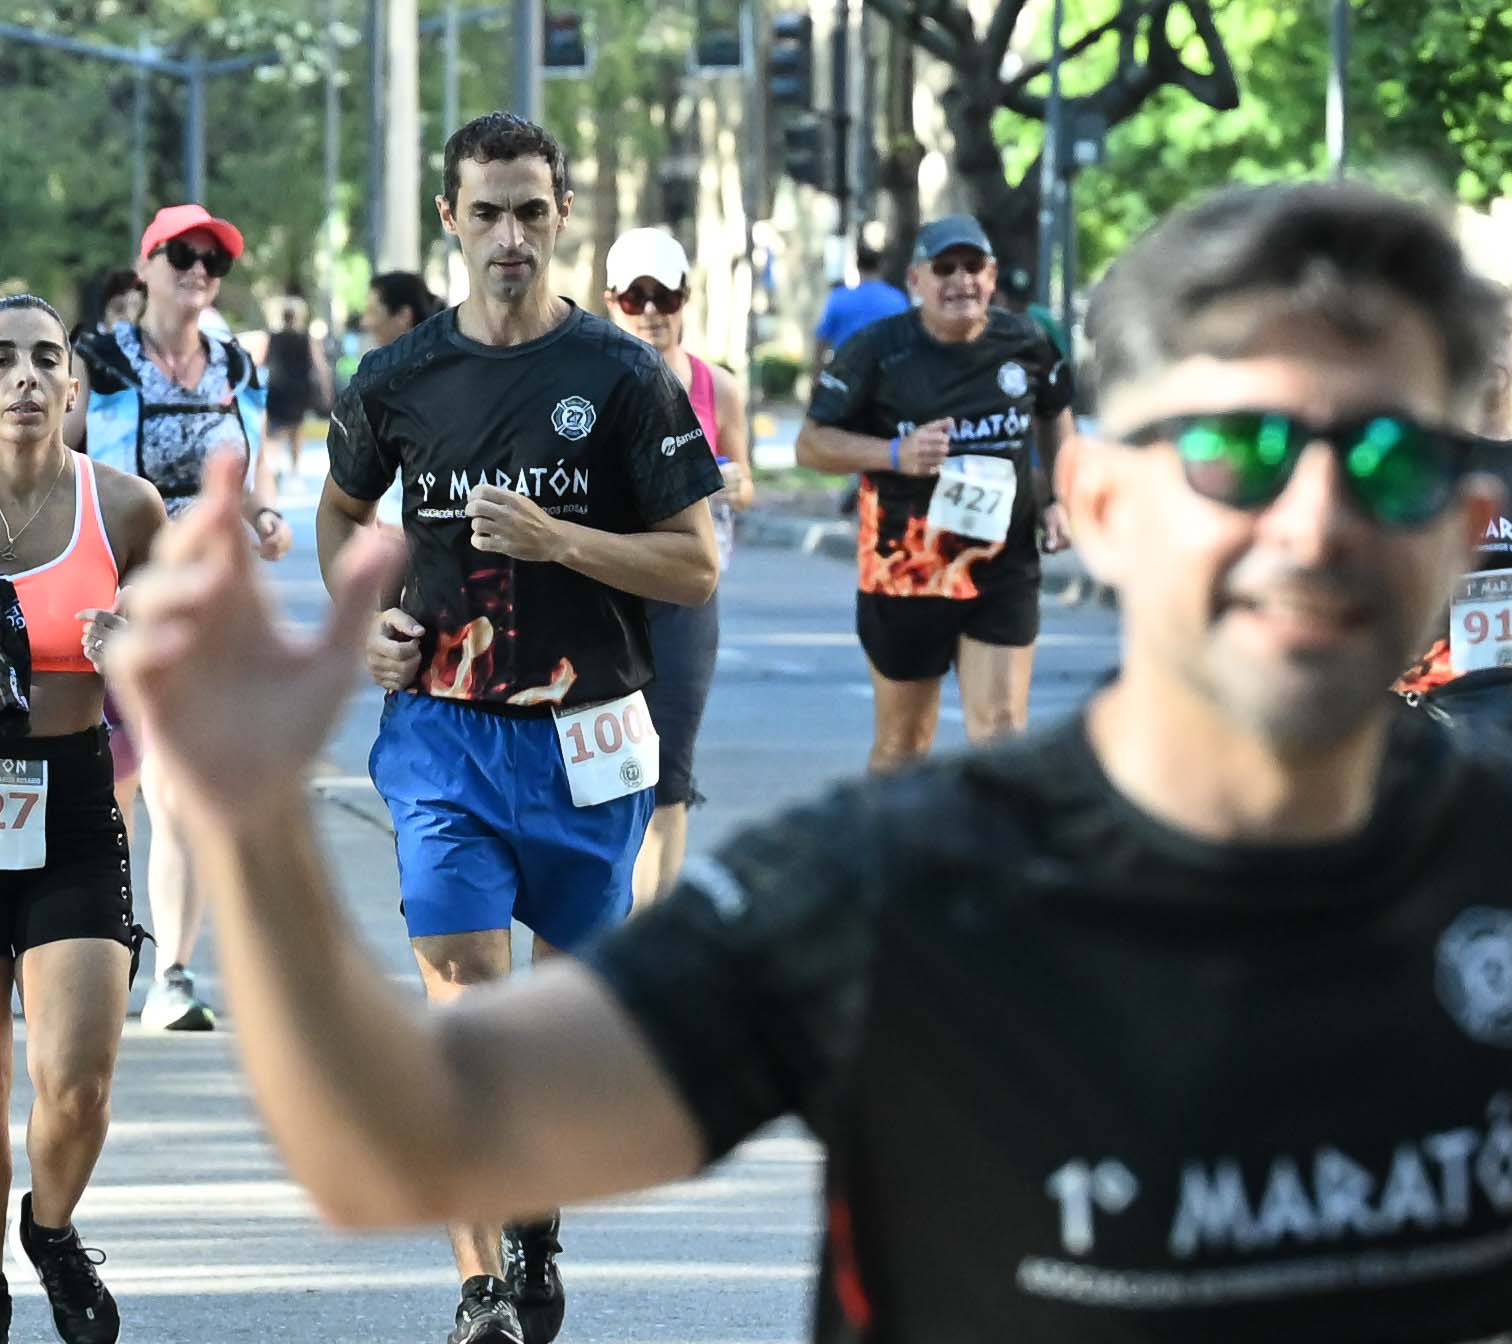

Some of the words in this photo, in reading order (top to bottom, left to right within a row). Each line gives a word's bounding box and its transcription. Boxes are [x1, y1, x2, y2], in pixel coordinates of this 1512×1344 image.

[566, 409, 584, 425] 27
[675, 428, 704, 448] Banco
[943, 481, 1004, 515] 427
